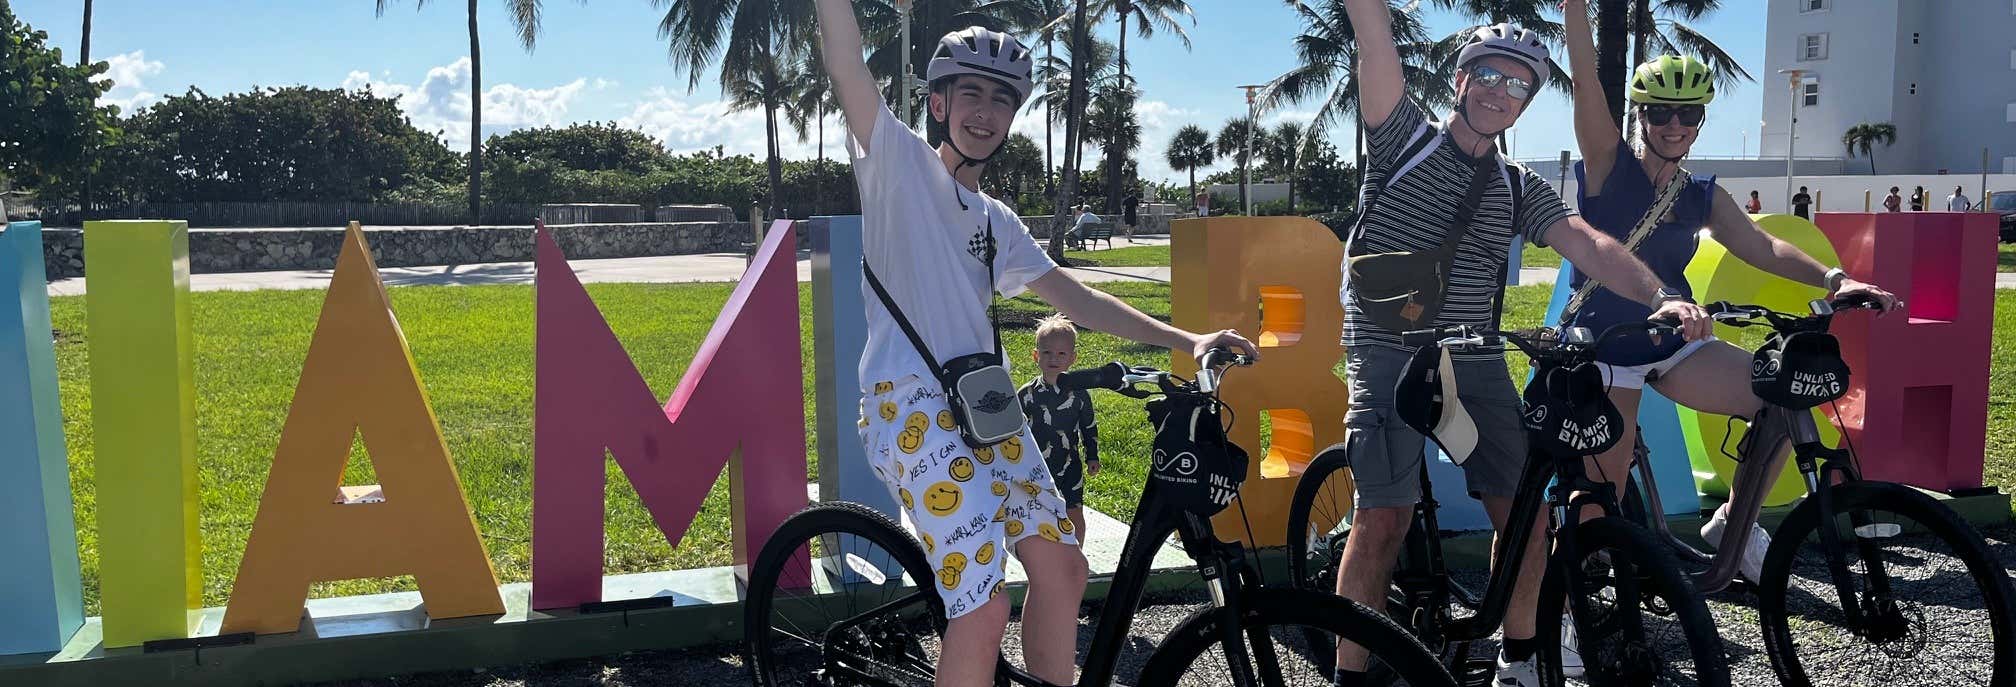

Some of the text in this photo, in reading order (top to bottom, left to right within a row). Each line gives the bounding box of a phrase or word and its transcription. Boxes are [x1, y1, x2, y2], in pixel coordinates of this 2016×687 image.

[0, 217, 905, 654] IAMI
[909, 458, 928, 481] YES
[930, 451, 938, 466] I
[1181, 458, 1191, 468] B
